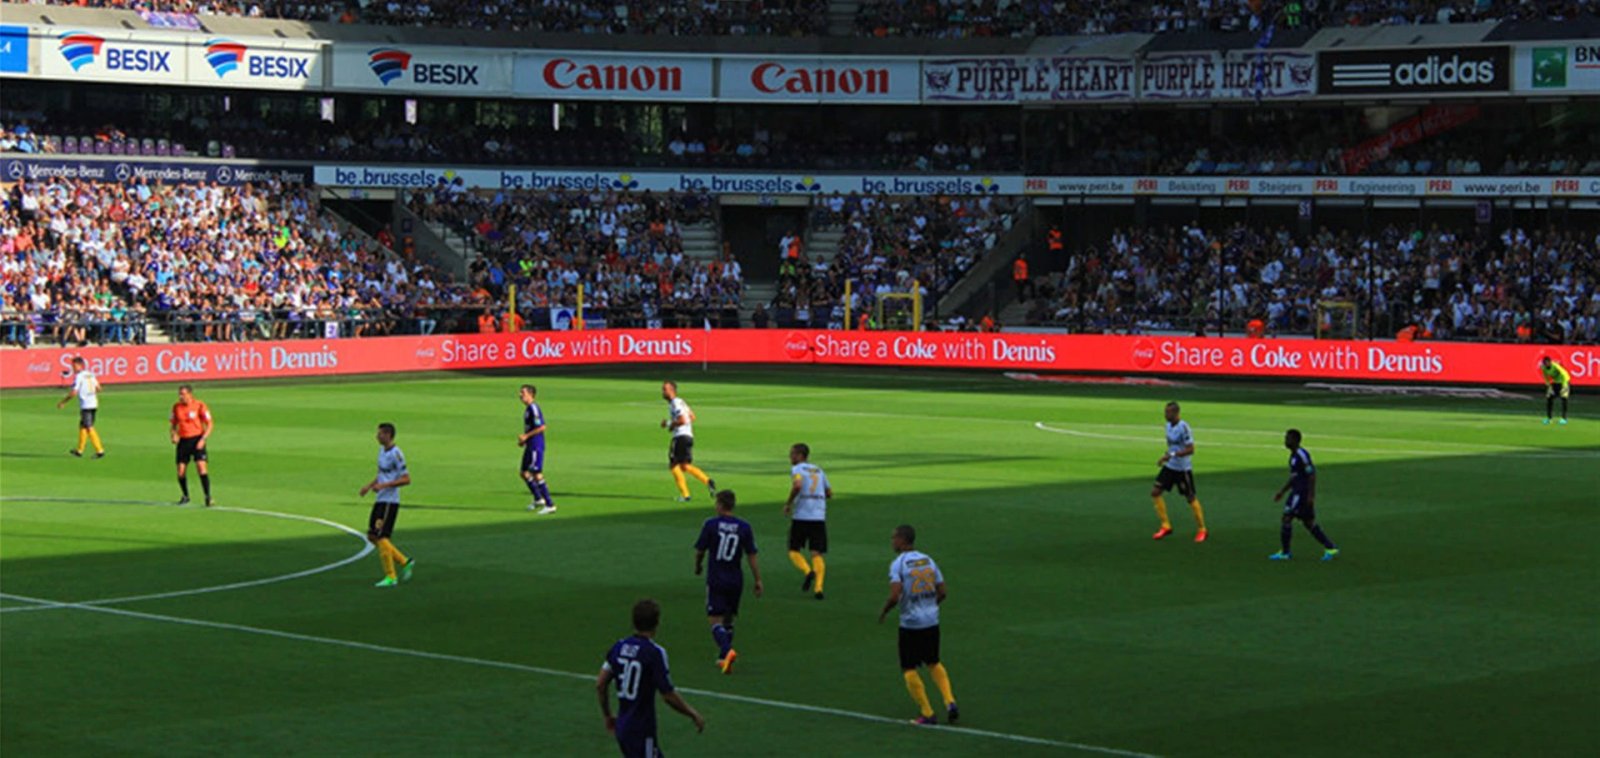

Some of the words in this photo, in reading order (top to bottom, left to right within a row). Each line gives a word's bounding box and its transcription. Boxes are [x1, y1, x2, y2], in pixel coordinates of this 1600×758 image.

[106, 48, 171, 72] BESIX
[249, 55, 309, 79] BESIX
[1575, 47, 1600, 62] BN
[413, 63, 478, 86] BESIX
[542, 57, 682, 92] Canon
[752, 62, 890, 94] Canon
[956, 65, 1049, 93] PURPLE
[1058, 64, 1133, 92] HEART
[1142, 60, 1215, 91] PURPLE
[1222, 60, 1286, 89] HEART
[1394, 55, 1495, 85] adidas
[27, 164, 104, 179] Mercedes-Benz
[133, 166, 207, 181] Mercedes-Benz
[335, 168, 436, 186] be.brussels
[500, 171, 610, 189] be.brussels
[679, 175, 793, 193] be.brussels
[862, 177, 973, 195] be.brussels
[1026, 179, 1047, 191] PERI
[1058, 182, 1124, 193] www.peri.be
[1137, 179, 1158, 191] PERI
[1168, 180, 1216, 194] Bekisting
[1228, 179, 1249, 191] PERI
[1258, 180, 1303, 194] Steigers
[1315, 179, 1338, 192] PERI
[1350, 180, 1416, 195] Engineering
[1429, 179, 1452, 192] PERI
[1463, 180, 1541, 194] www.peri.be
[1554, 179, 1579, 192] PERI
[135, 355, 149, 375] a
[156, 349, 208, 374] Coke
[214, 347, 264, 371] with
[271, 344, 338, 369] Dennis
[441, 340, 499, 363] Share
[504, 343, 516, 361] a
[522, 336, 566, 359] Coke
[571, 336, 612, 357] with
[618, 333, 693, 356] Dennis
[815, 334, 870, 358] Share
[876, 341, 888, 358] a
[893, 336, 938, 360] Coke
[943, 338, 986, 361] with
[992, 337, 1056, 363] Dennis
[1160, 341, 1224, 366] Share
[1230, 348, 1245, 368] a
[1250, 343, 1302, 369] Coke
[1308, 345, 1360, 370] with
[1367, 346, 1443, 374] Dennis
[716, 531, 739, 562] 10
[616, 657, 642, 700] 30
